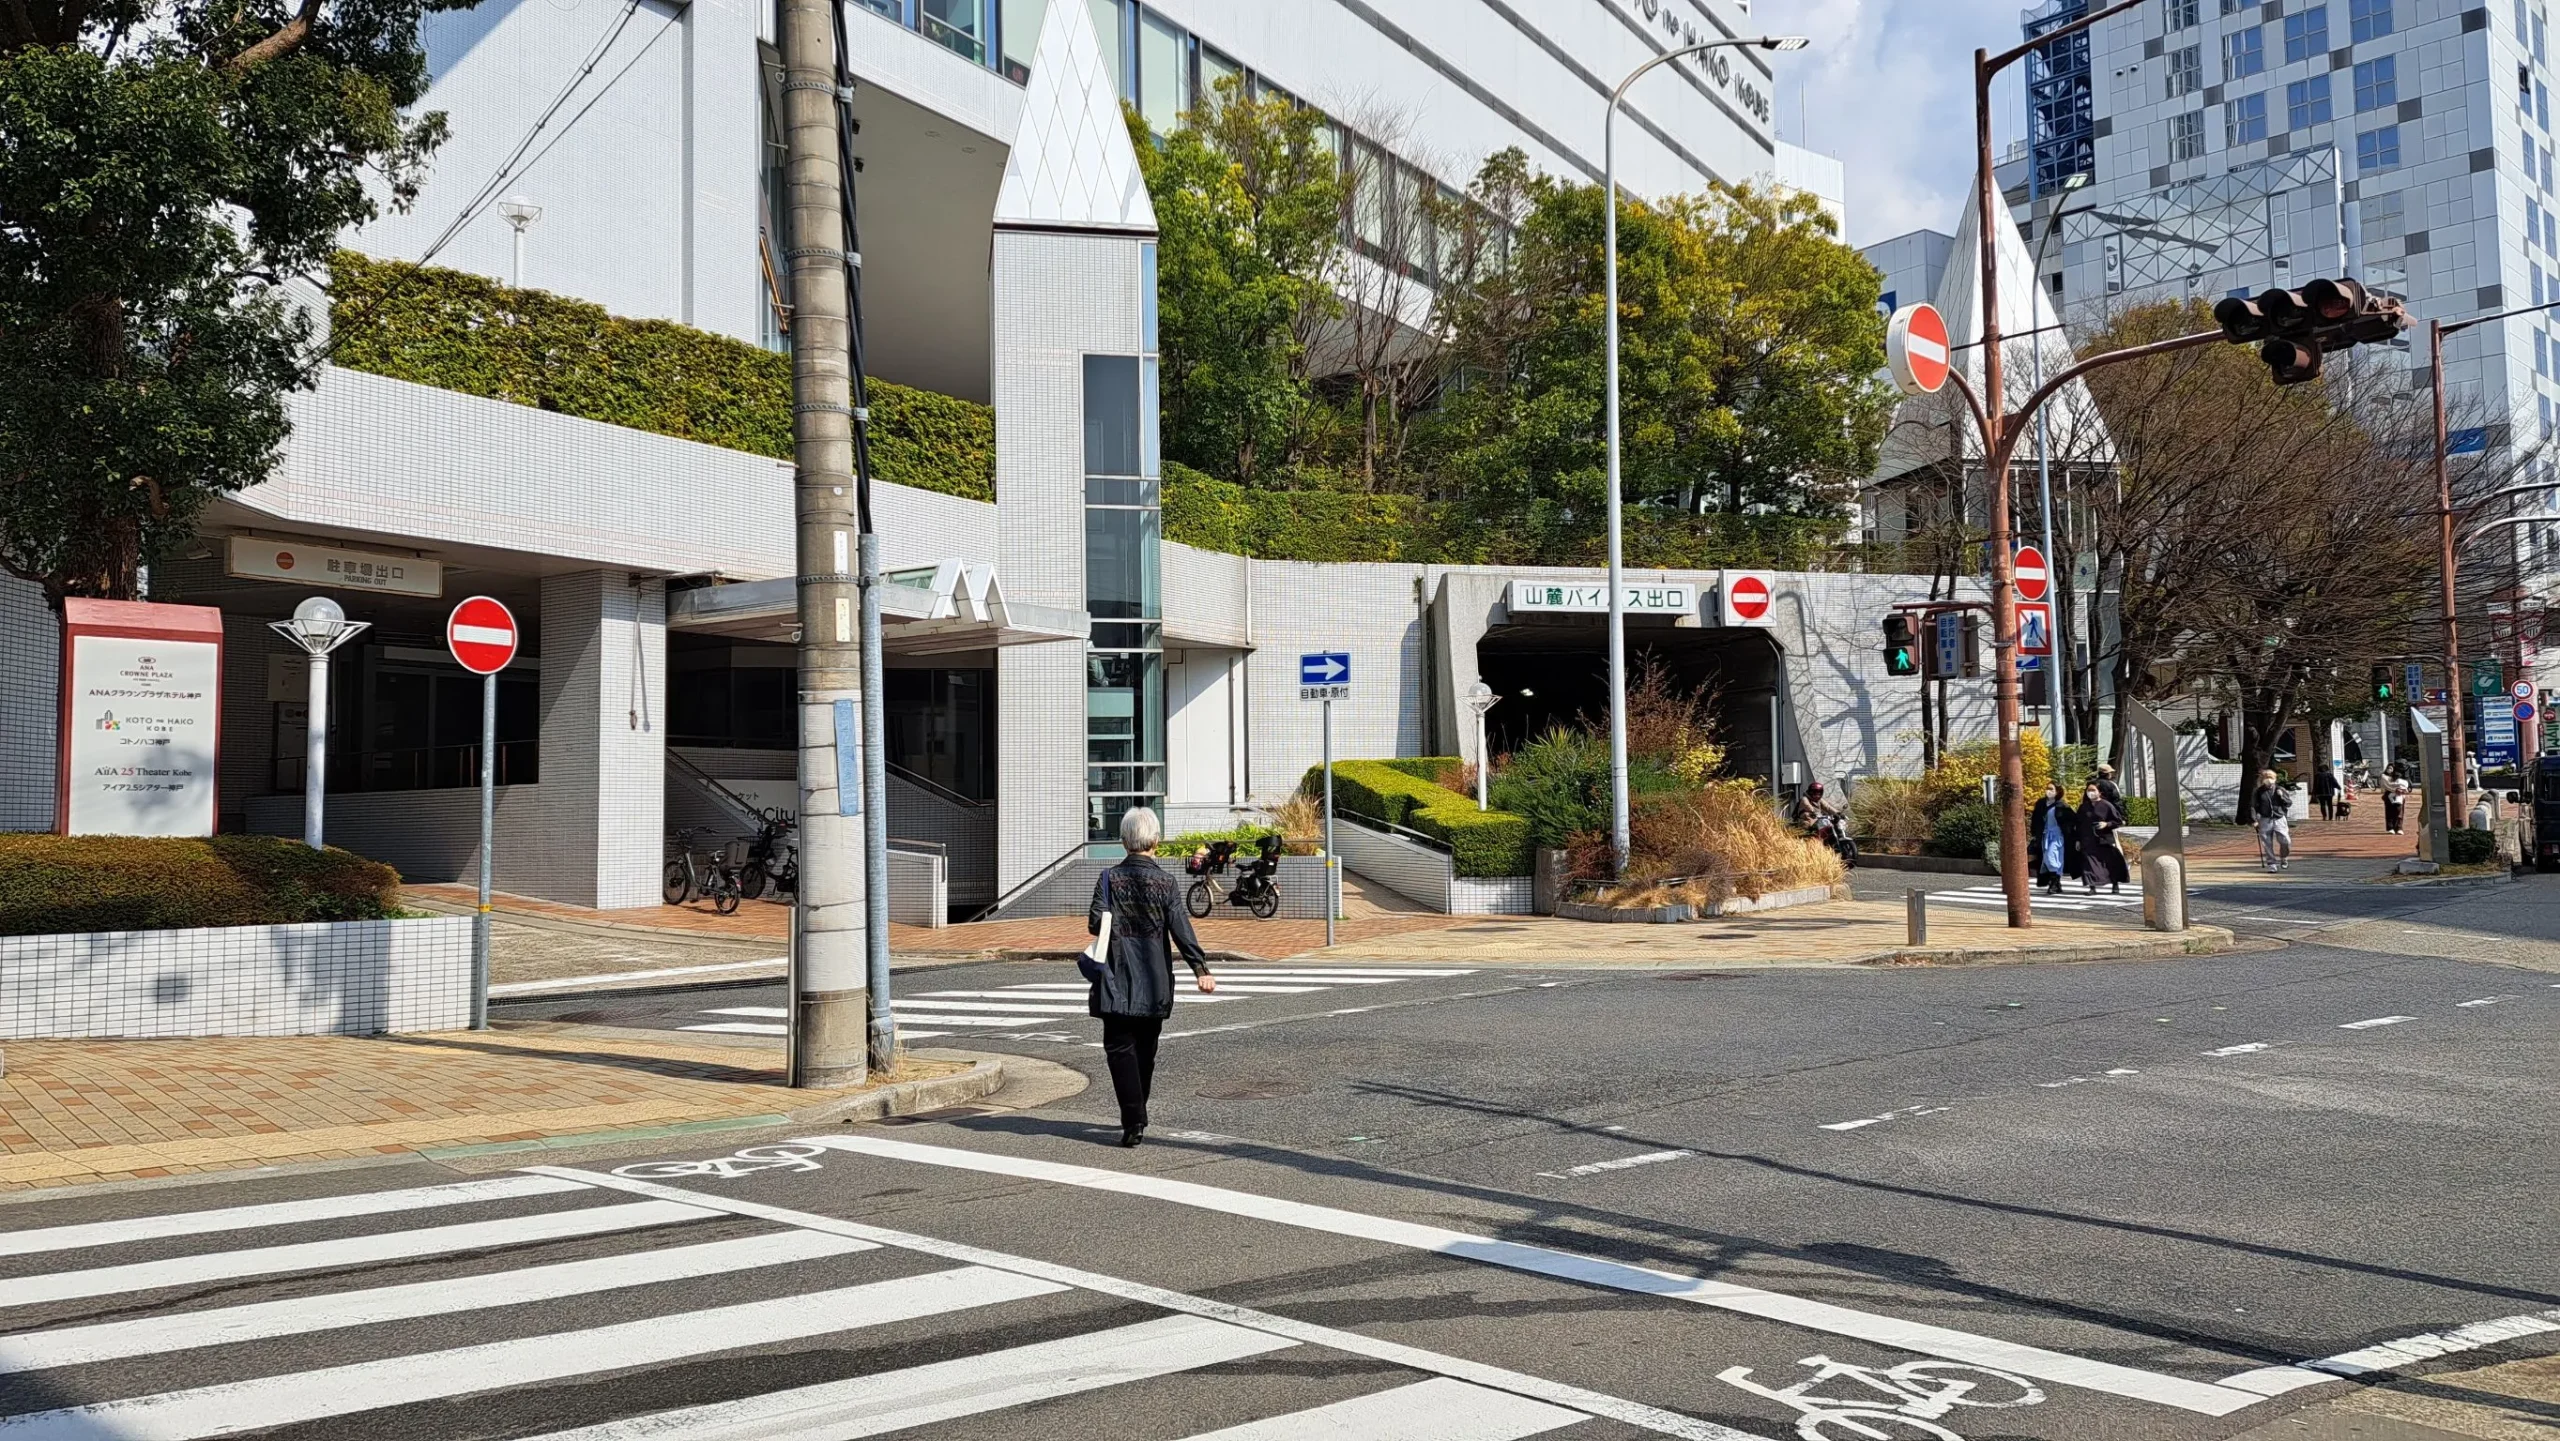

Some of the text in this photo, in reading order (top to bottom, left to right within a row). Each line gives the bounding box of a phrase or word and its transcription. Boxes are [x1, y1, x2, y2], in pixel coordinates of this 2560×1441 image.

[1683, 20, 1730, 89] HAKO
[1735, 72, 1770, 125] KOBE
[326, 558, 405, 580] 駐車場出口
[343, 574, 388, 586] PARKING OUT
[1525, 587, 1684, 608] 山麓バイス出口
[119, 670, 173, 679] CROWNE PLAZA
[88, 688, 202, 700] ANAクラウンプラザホテル神戸
[2516, 685, 2529, 695] 50
[167, 717, 194, 725] HAKO
[119, 738, 171, 746] コトノハコ神戸
[136, 767, 170, 776] Theater
[172, 768, 193, 777] Kobe
